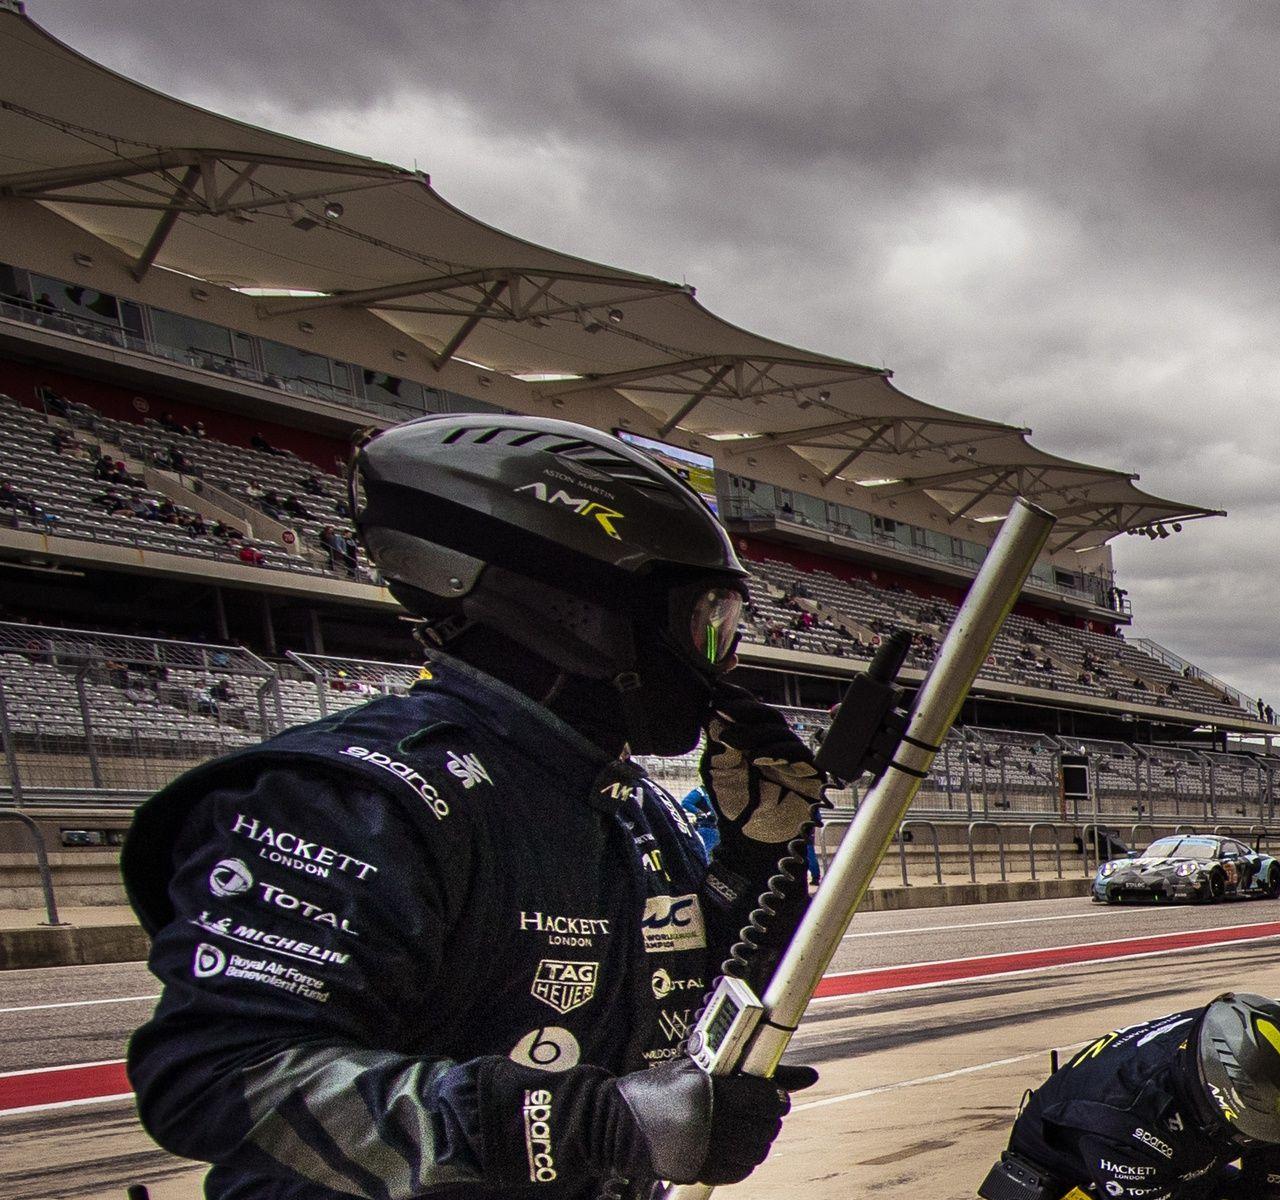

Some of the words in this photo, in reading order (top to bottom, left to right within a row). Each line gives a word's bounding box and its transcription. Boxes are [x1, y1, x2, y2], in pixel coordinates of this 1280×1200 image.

[543, 469, 574, 483] ASTON
[578, 481, 615, 500] MARTIN
[513, 482, 625, 541] AMR
[339, 746, 450, 820] sparco
[230, 814, 378, 881] HACKETT
[259, 848, 329, 879] LONDON
[259, 882, 360, 935] TOTAL
[520, 911, 610, 935] HACKETT
[234, 925, 351, 966] MICHELIN
[549, 936, 593, 948] LONDON
[229, 954, 267, 974] Royal
[285, 967, 325, 990] Force
[544, 963, 593, 983] TAG
[537, 984, 592, 1010] HEUER
[1207, 1083, 1239, 1122] AMR
[523, 1089, 557, 1183] sparco
[1132, 1127, 1174, 1159] sparco
[1100, 1159, 1157, 1176] HACKETT
[1114, 1173, 1145, 1181] LONDON
